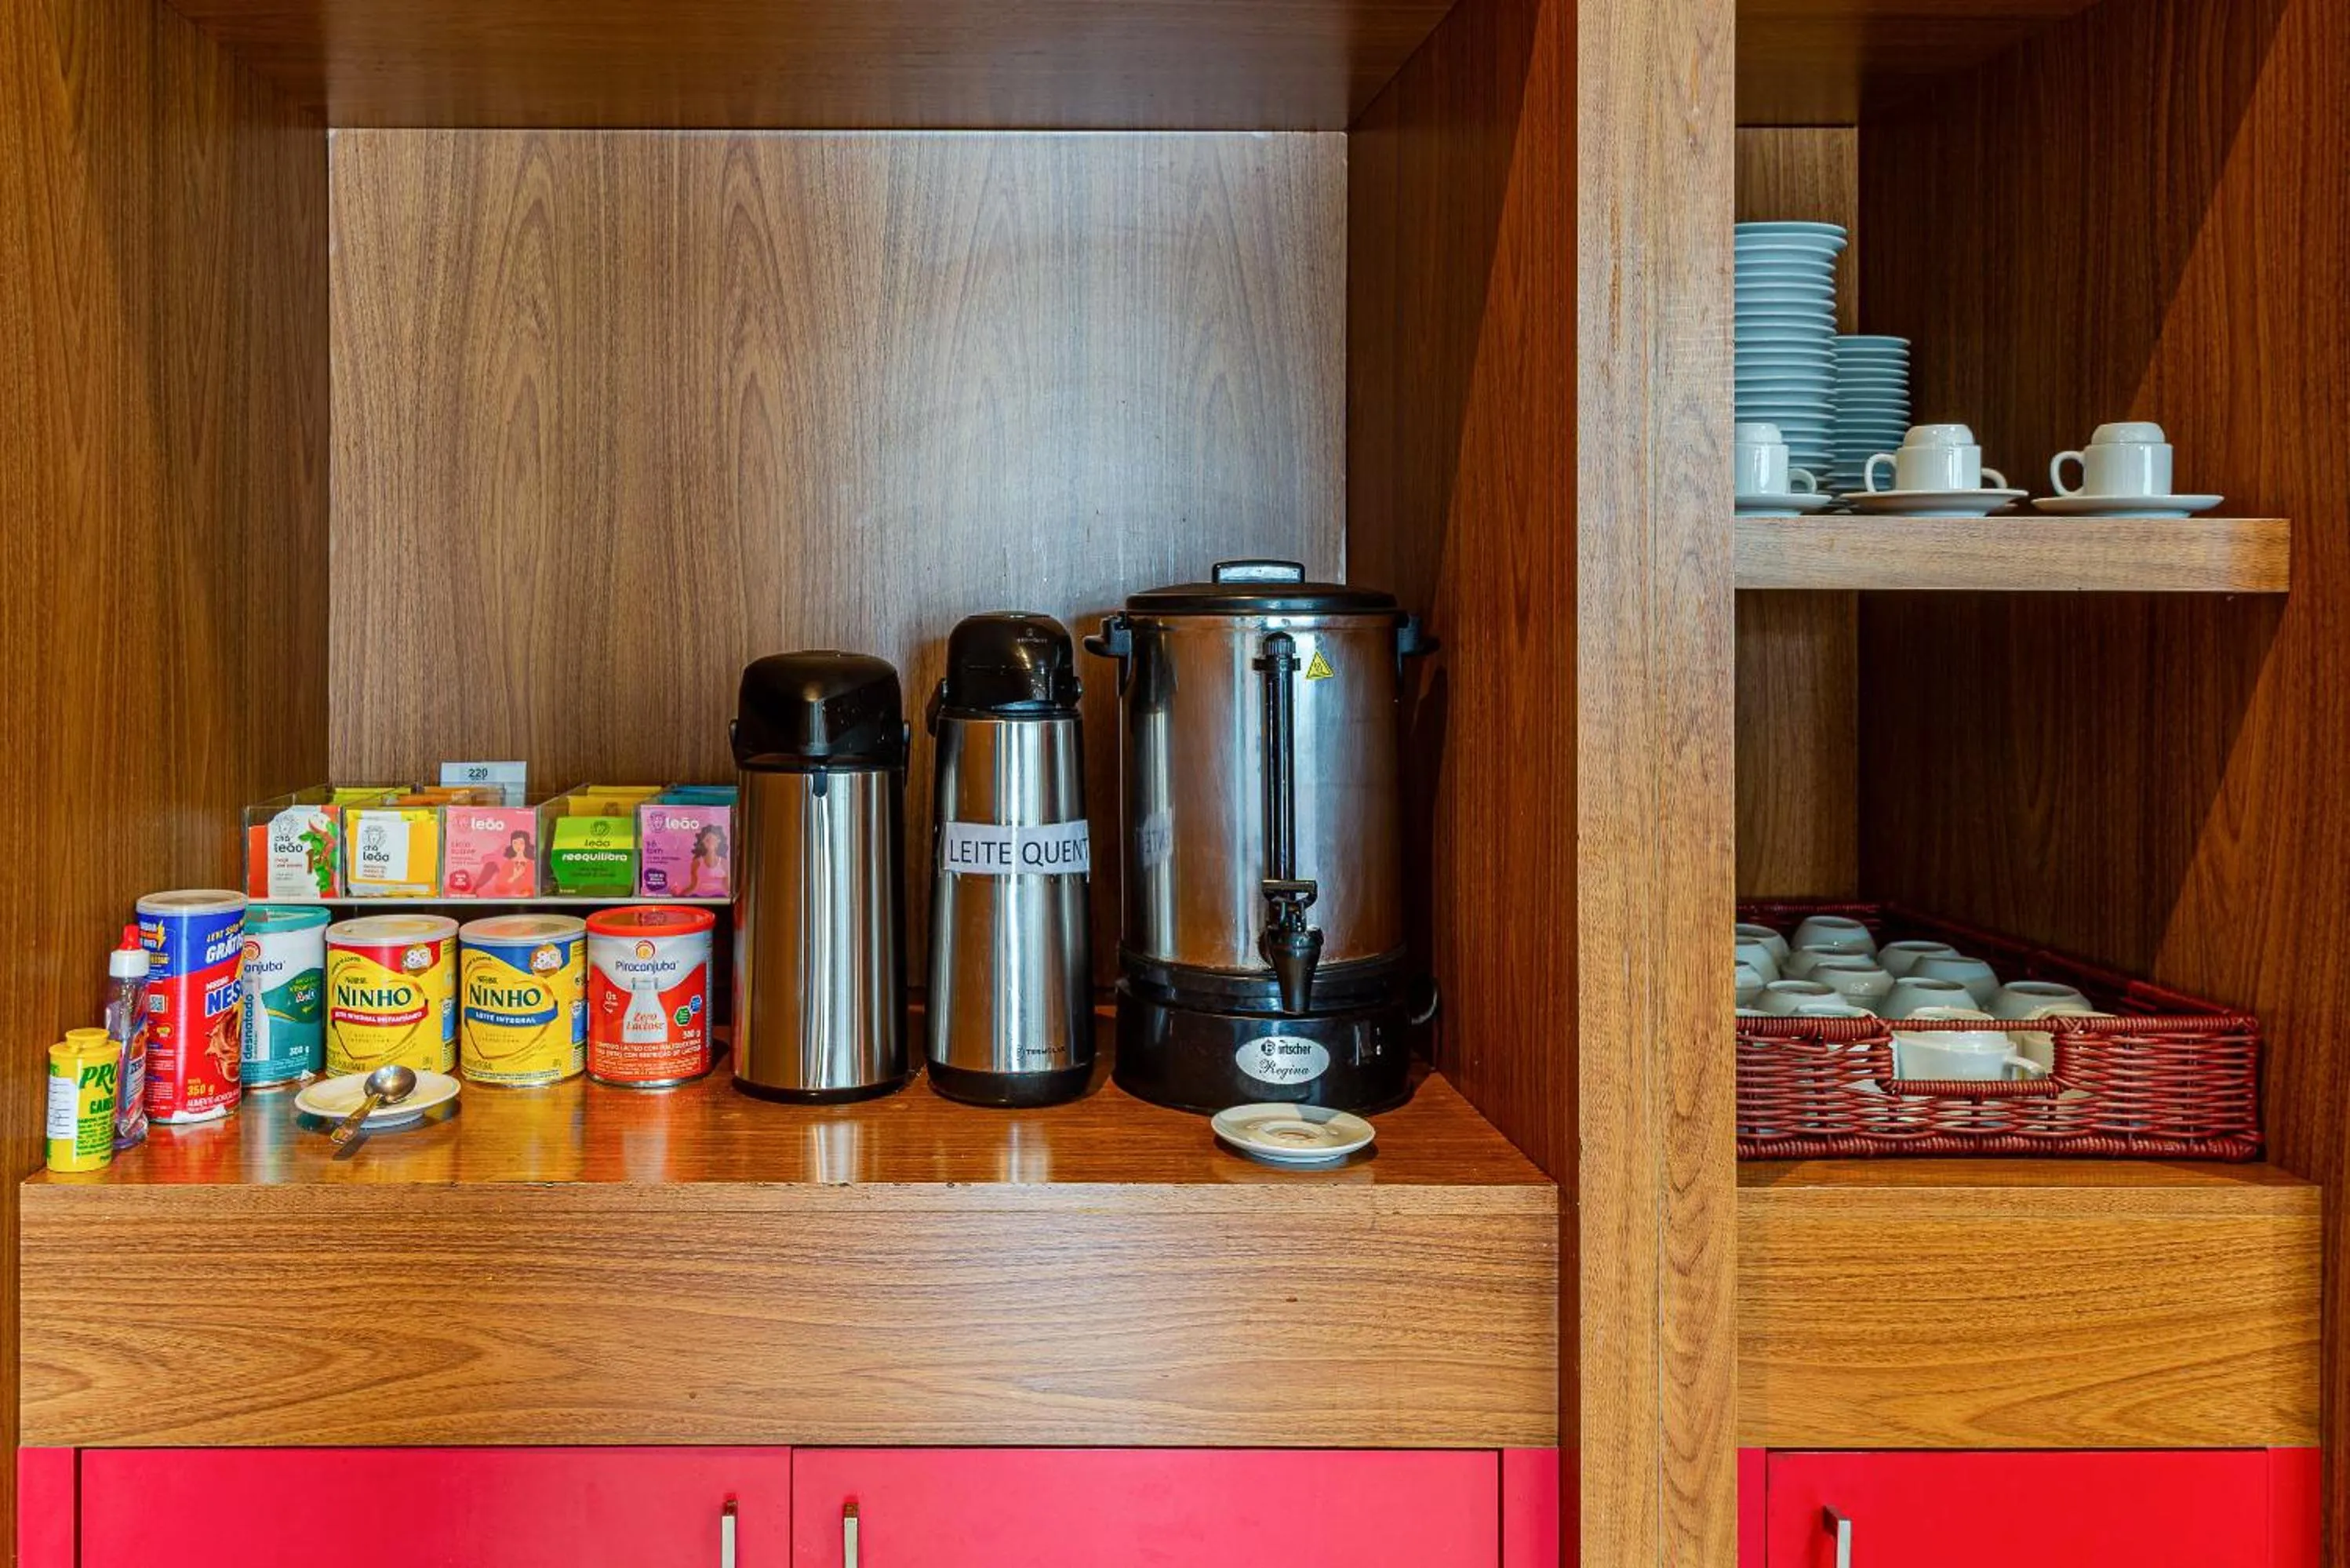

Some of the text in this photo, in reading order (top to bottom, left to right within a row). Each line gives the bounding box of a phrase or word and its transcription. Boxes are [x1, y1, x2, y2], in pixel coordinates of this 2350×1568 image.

[467, 768, 488, 780] 220
[471, 817, 505, 831] leão
[665, 817, 700, 830] leão
[274, 843, 304, 853] leão
[362, 852, 391, 862] leão
[949, 839, 1013, 864] LEITE
[615, 960, 677, 974] Piracanjuba
[205, 979, 243, 1018] NES
[337, 984, 413, 1007] NINHO
[469, 984, 541, 1008] NINHO
[243, 993, 254, 1060] desnatado
[1259, 1058, 1311, 1080] Regina
